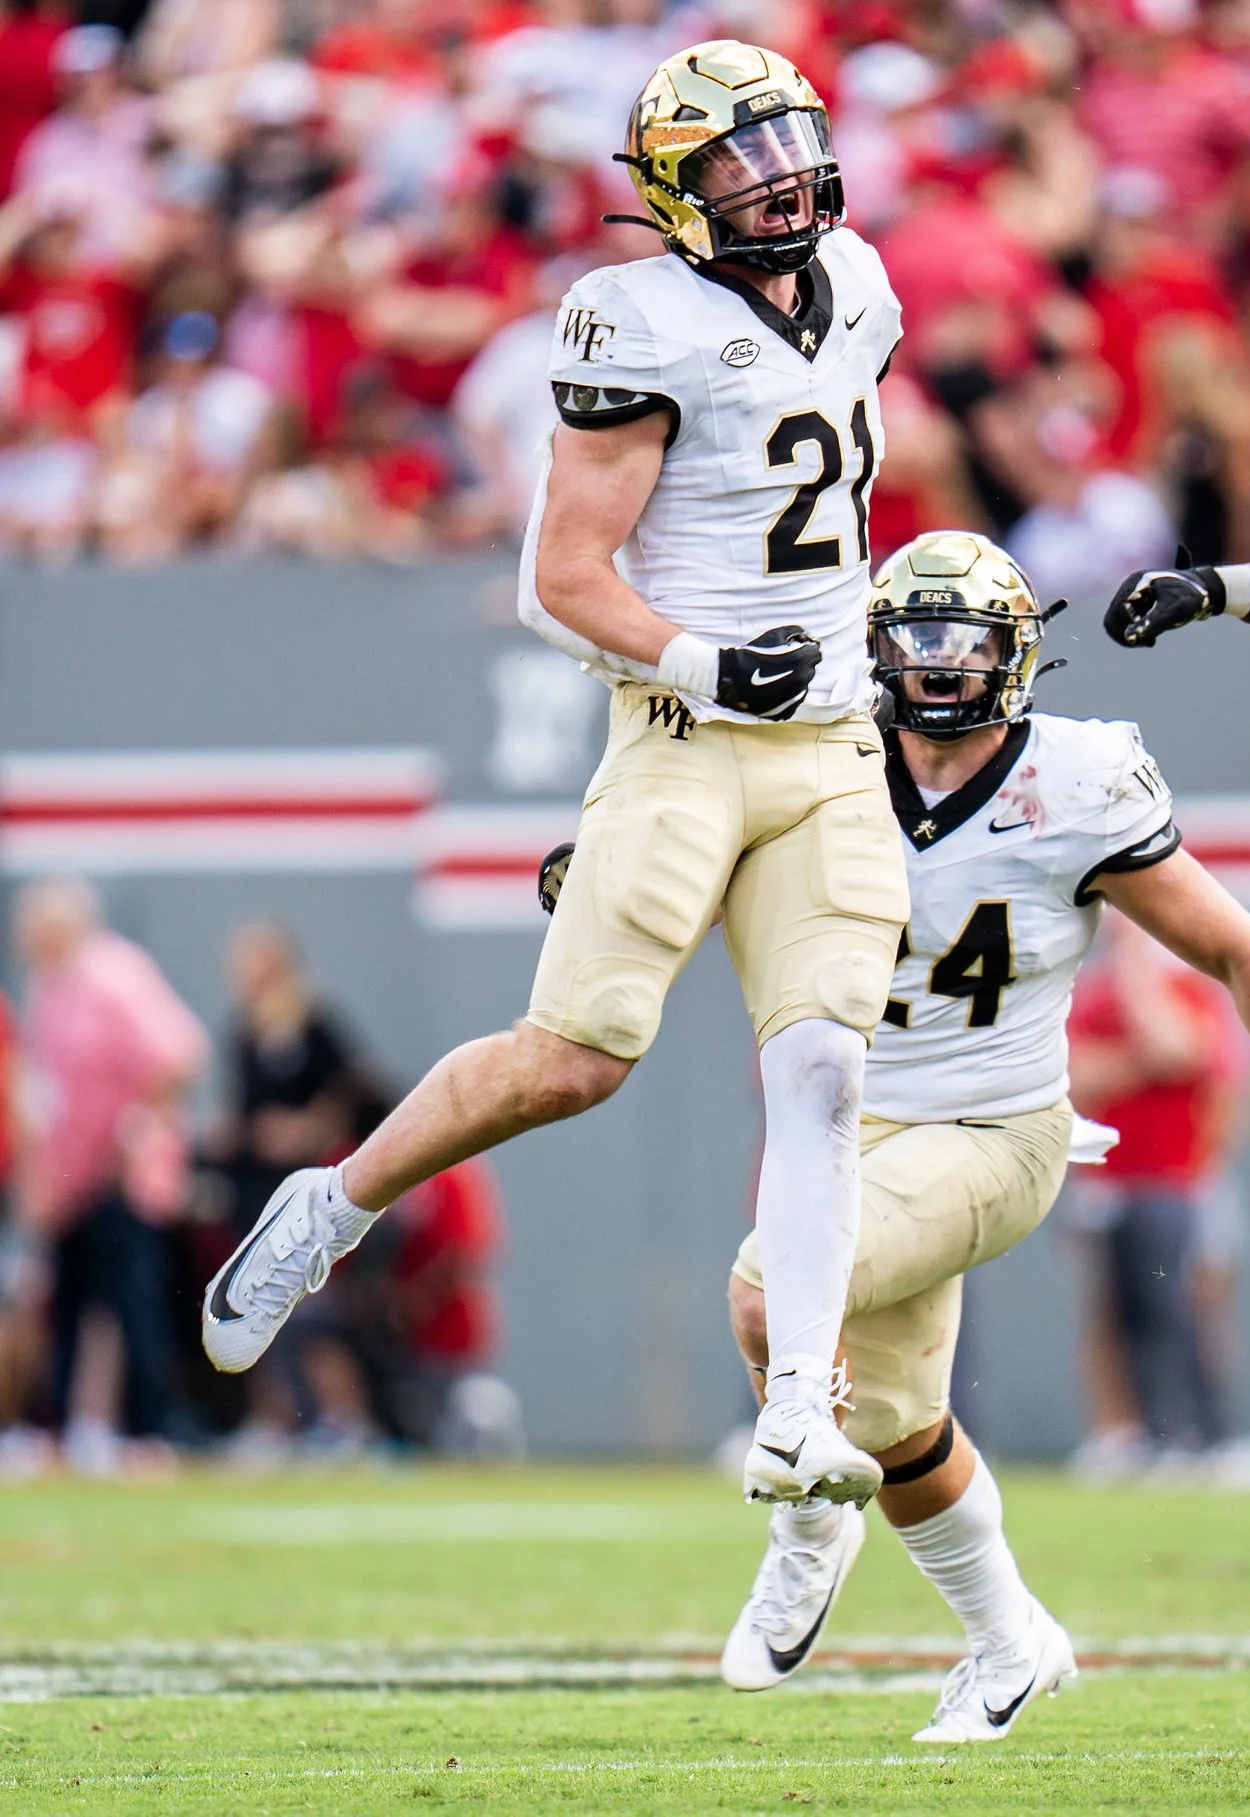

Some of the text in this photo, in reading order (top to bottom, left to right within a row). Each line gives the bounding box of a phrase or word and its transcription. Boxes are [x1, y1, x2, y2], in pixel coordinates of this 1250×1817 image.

[748, 92, 782, 112] DEACS
[562, 307, 617, 363] WF
[728, 343, 754, 359] ACC
[763, 396, 879, 576] 21
[919, 591, 952, 604] DEACS
[647, 695, 696, 741] WF
